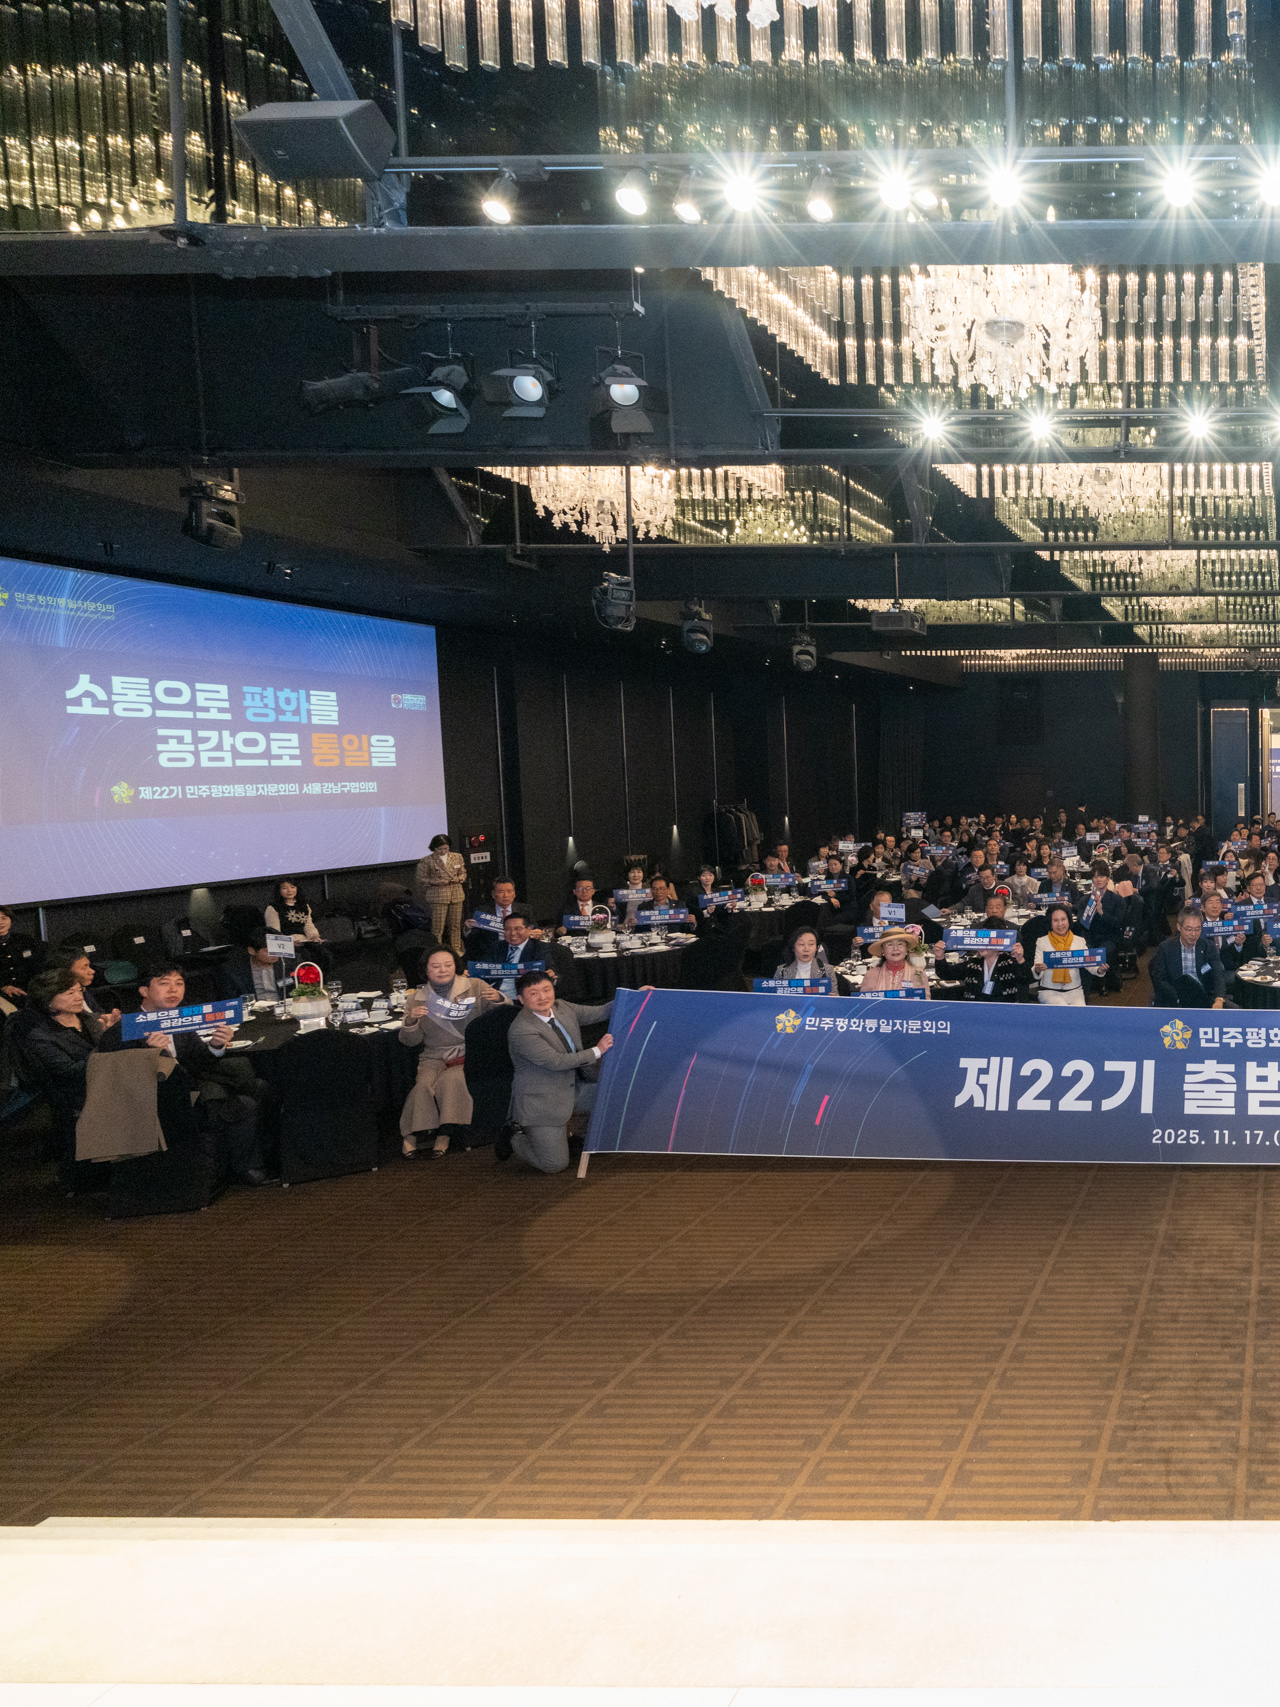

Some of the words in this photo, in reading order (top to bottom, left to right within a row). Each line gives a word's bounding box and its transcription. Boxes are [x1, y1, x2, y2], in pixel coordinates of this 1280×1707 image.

[65, 674, 232, 720] 소통으로
[242, 686, 339, 725] 평화를
[156, 729, 302, 768] 공감으로
[311, 733, 396, 767] 통일을
[138, 786, 182, 800] 제22기
[186, 784, 299, 798] 민주평화통일자문회의
[302, 782, 377, 795] 서울강남구협의회
[135, 1010, 179, 1023] 소통으로
[160, 1015, 202, 1028] 공감으로
[804, 1016, 950, 1034] 민주평화통일자문회의
[954, 1056, 1156, 1114] 제22기
[1152, 1128, 1206, 1144] 2025.
[1214, 1130, 1236, 1146] 11.
